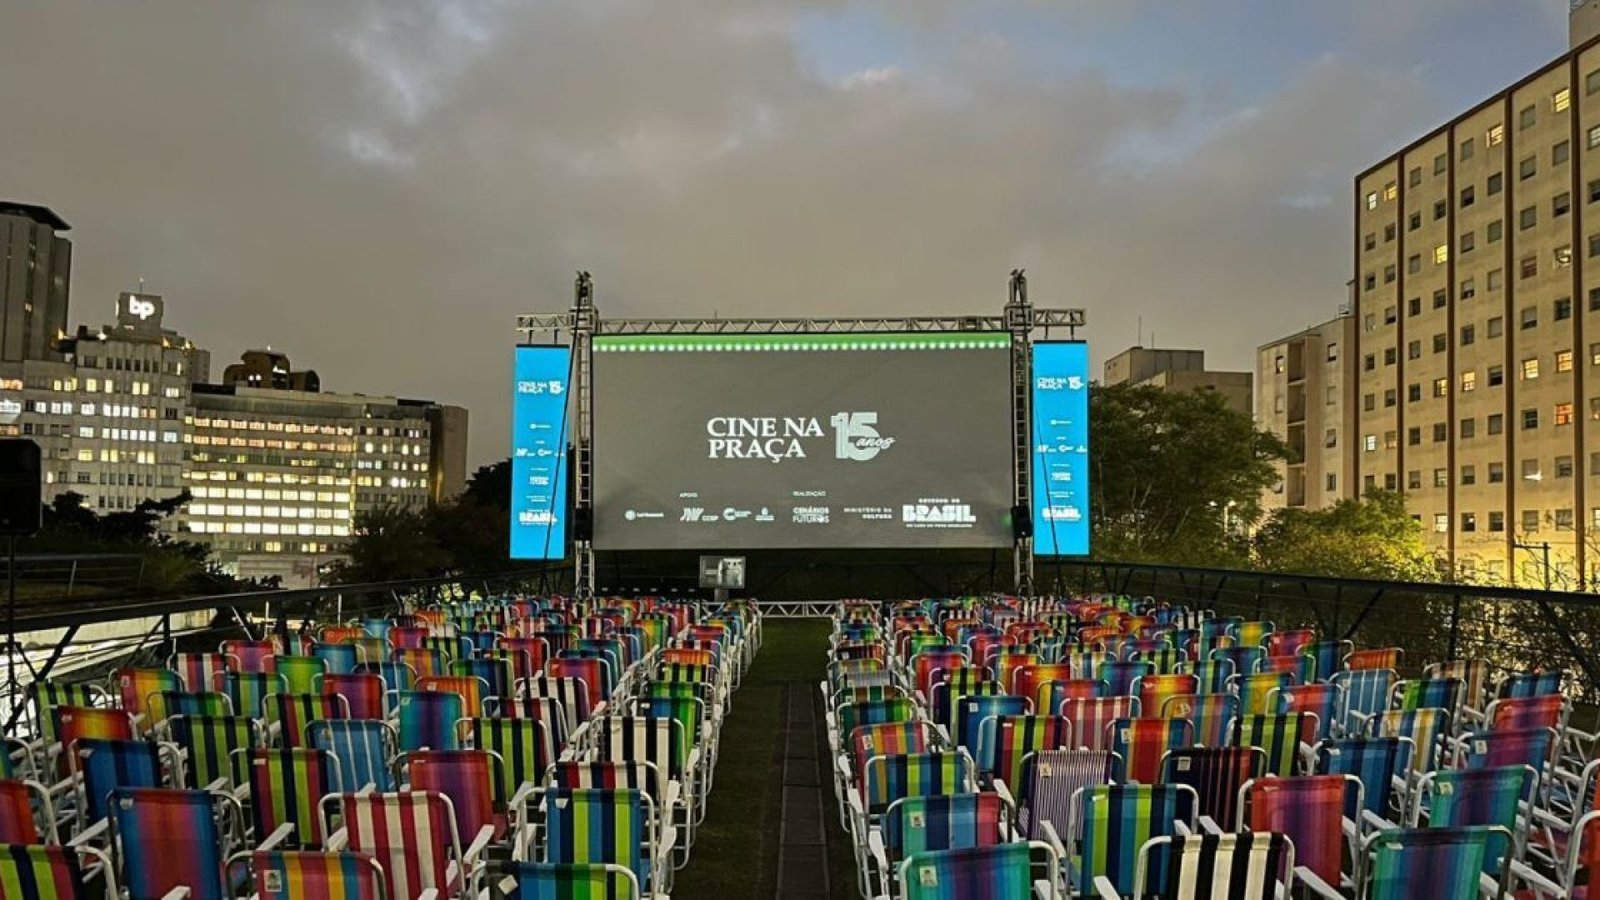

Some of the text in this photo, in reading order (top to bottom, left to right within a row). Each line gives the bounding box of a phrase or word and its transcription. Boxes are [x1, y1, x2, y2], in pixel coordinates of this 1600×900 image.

[129, 295, 155, 320] bp
[706, 417, 825, 437] CINE NA
[830, 412, 881, 461] 15
[708, 438, 807, 463] PRAÇA
[856, 437, 896, 450] anos
[792, 515, 830, 523] FUTUROS
[902, 504, 977, 522] BRASIL
